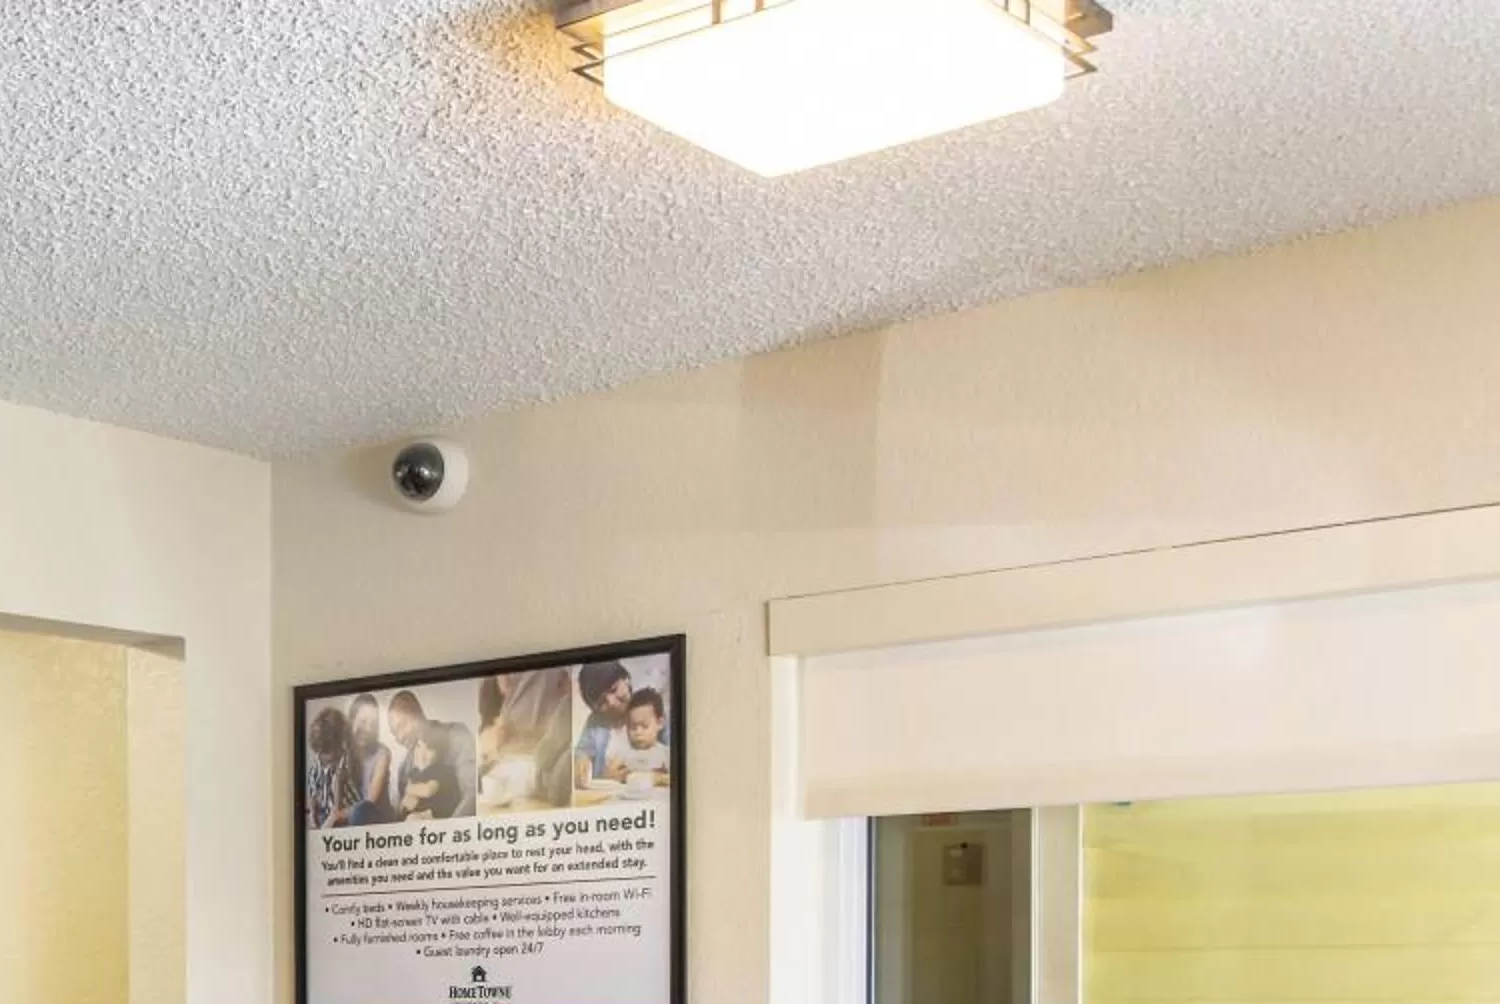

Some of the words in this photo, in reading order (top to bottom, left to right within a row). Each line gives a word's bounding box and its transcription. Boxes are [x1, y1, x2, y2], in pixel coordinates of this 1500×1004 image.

[322, 835, 360, 852] Your
[366, 832, 413, 849] home
[420, 827, 446, 845] for
[452, 828, 471, 843] as
[477, 823, 518, 844] long
[525, 824, 545, 837] as
[552, 821, 589, 840] you
[596, 810, 655, 832] need!
[375, 857, 398, 867] clean
[402, 856, 418, 865] and
[421, 851, 479, 864] comfortable
[481, 850, 508, 861] place
[511, 849, 522, 859] to
[526, 847, 545, 857] rest
[550, 846, 571, 858] your
[609, 839, 633, 850] with
[636, 839, 654, 849] the
[327, 875, 369, 886] amenities
[372, 874, 388, 886] you
[392, 871, 413, 882] need
[417, 869, 434, 880] and
[438, 868, 452, 878] the
[456, 868, 480, 878] value
[484, 867, 502, 878] you
[506, 864, 530, 875] want
[533, 862, 548, 873] for
[552, 863, 564, 871] an
[568, 858, 618, 871] extended
[622, 857, 646, 870] stay.
[396, 899, 428, 913] Weekly
[431, 895, 498, 911] housekeeping
[502, 895, 542, 907] services
[553, 892, 576, 903] Free
[580, 889, 620, 901] in-room
[357, 918, 372, 928] HD
[375, 917, 422, 928] flat-screen
[426, 915, 438, 925] TV
[441, 914, 460, 924] with
[464, 912, 489, 924] cable
[501, 910, 574, 922] Well-equipped
[577, 907, 620, 919] kitchens
[341, 933, 360, 946] Fully
[364, 930, 406, 943] furnished
[410, 931, 438, 941] rooms
[450, 929, 470, 940] Free
[473, 928, 503, 940] coffee
[506, 927, 514, 937] in
[517, 927, 534, 938] the
[537, 925, 566, 939] lobby
[569, 924, 592, 935] each
[597, 925, 641, 937] morning
[455, 945, 491, 959] laundry
[494, 946, 518, 958] open
[521, 942, 544, 954] 24/7
